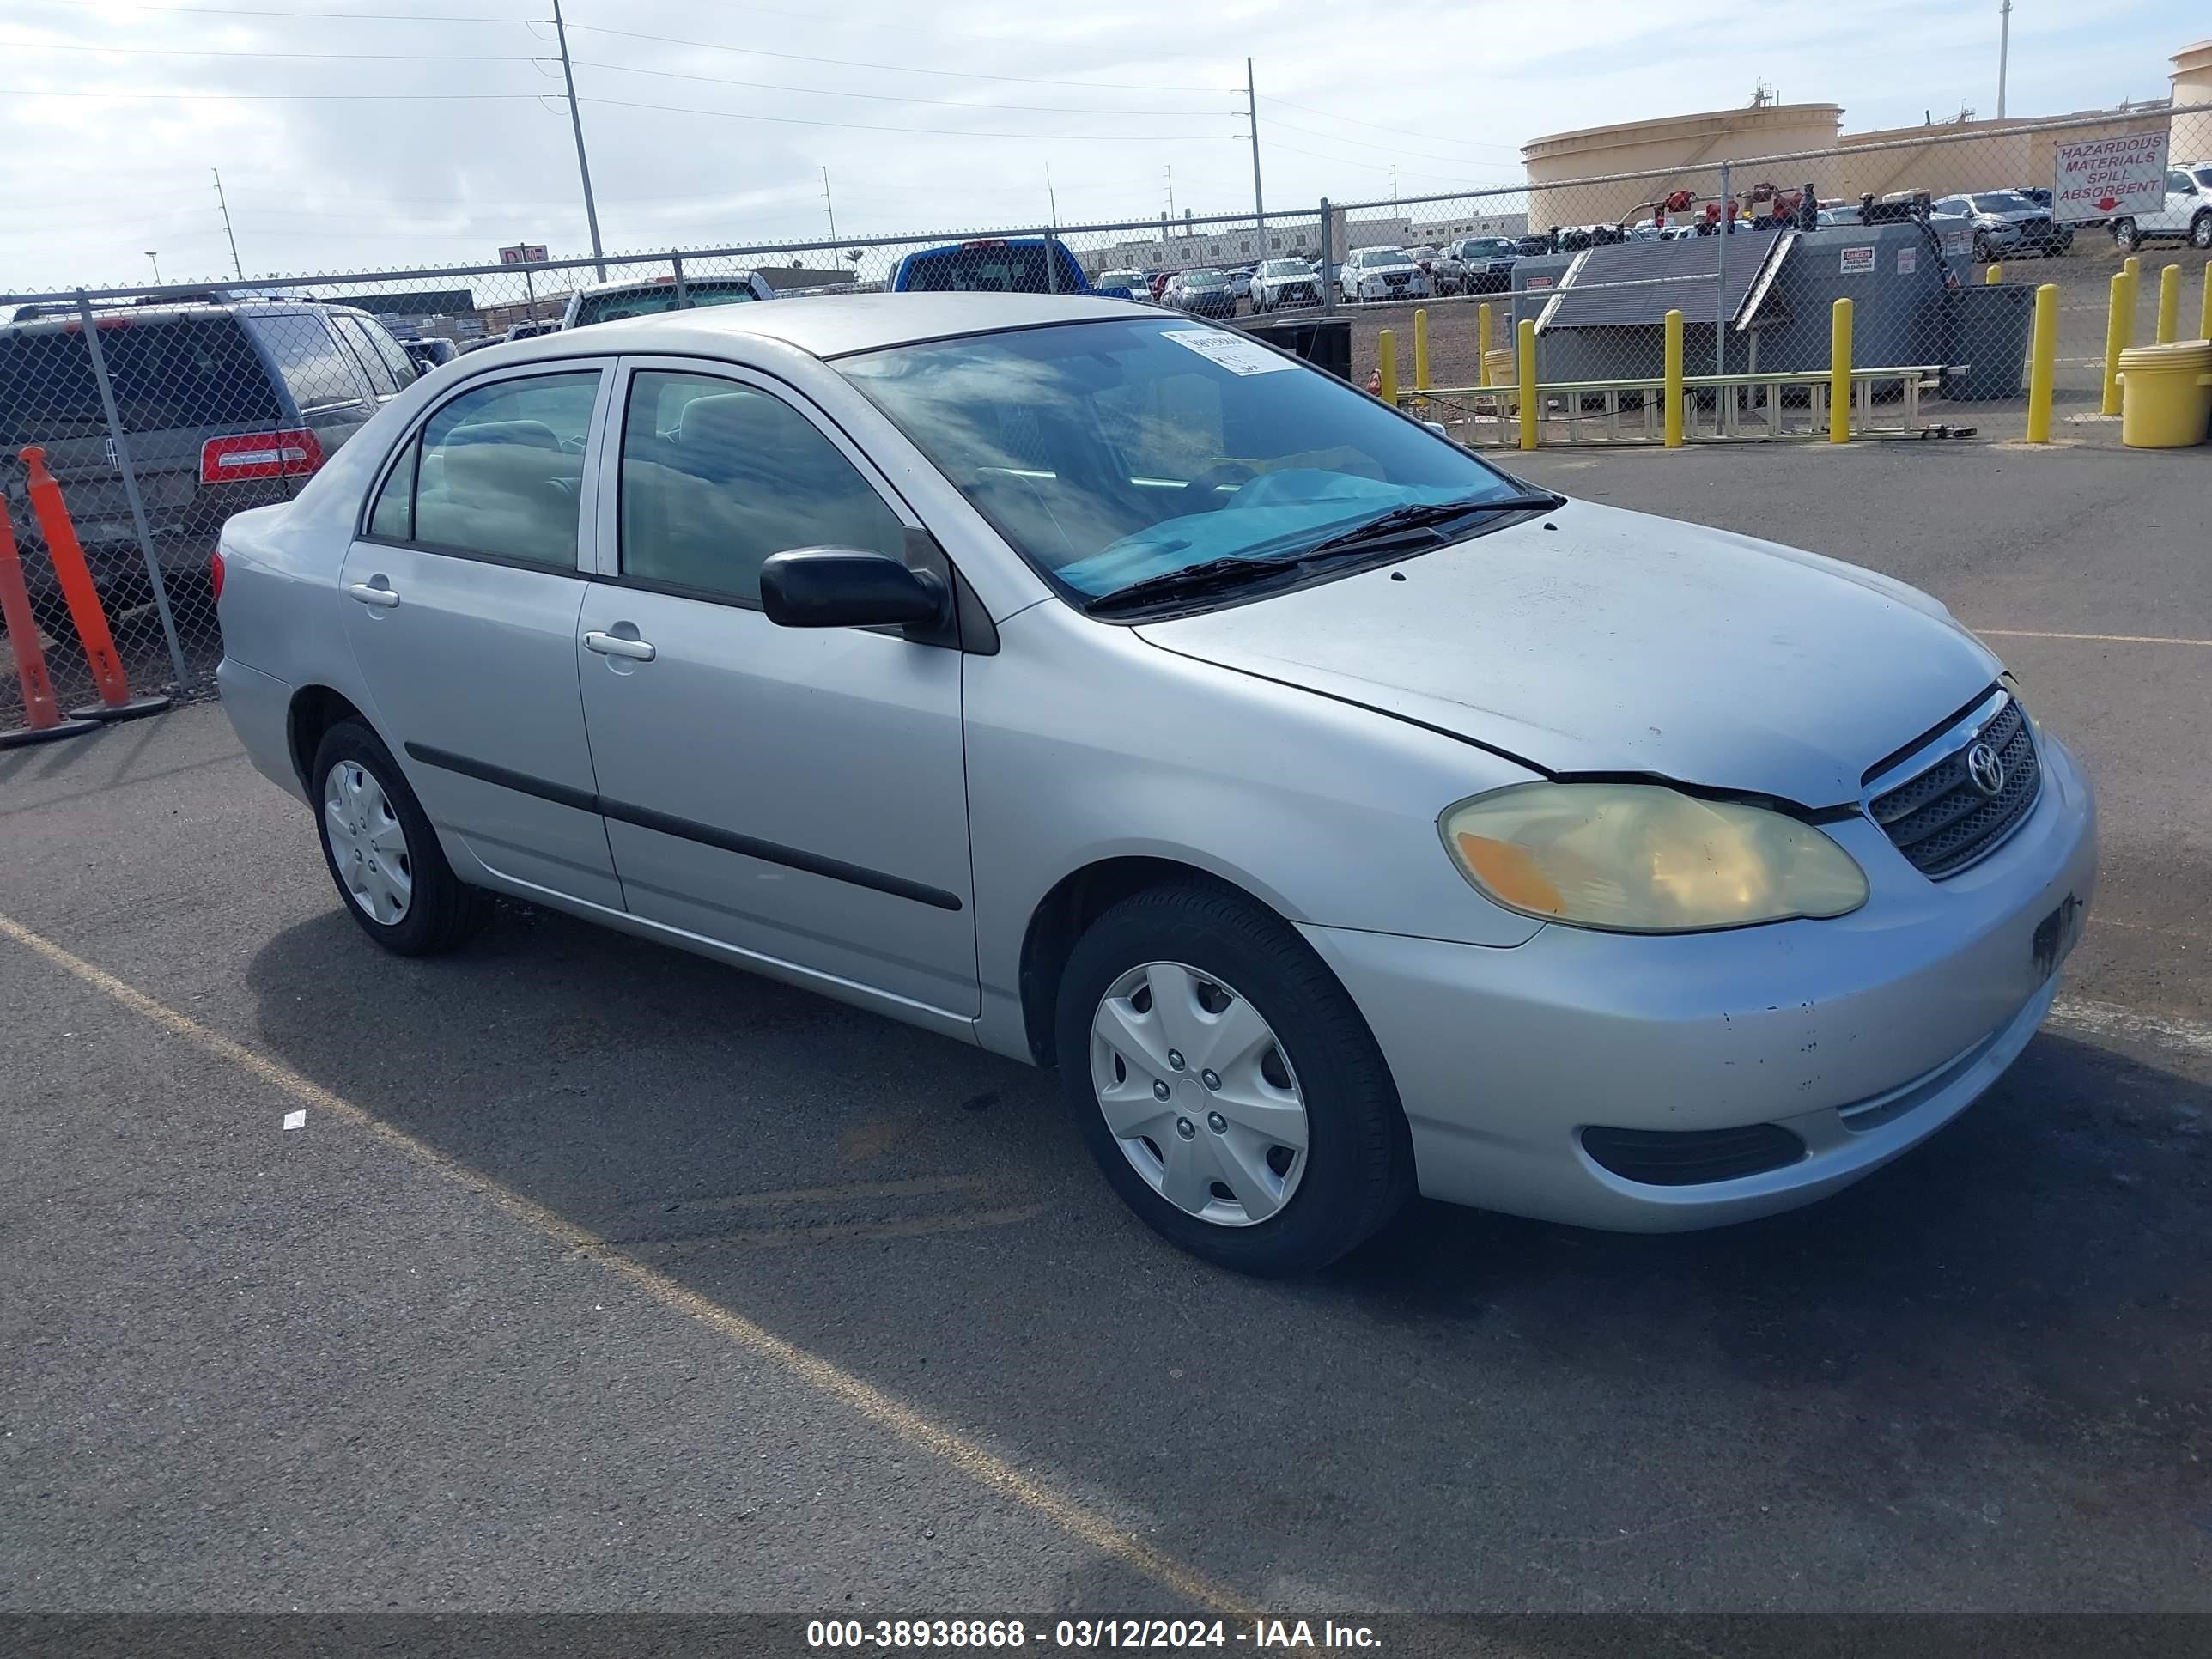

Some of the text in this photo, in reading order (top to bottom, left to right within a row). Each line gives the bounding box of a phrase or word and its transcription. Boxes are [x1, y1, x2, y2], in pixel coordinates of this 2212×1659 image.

[2061, 136, 2162, 159] HAZARDOUS
[2065, 151, 2156, 172] MATERIALS
[2087, 169, 2130, 184] SPILL
[2059, 179, 2160, 201] ABSORBENT
